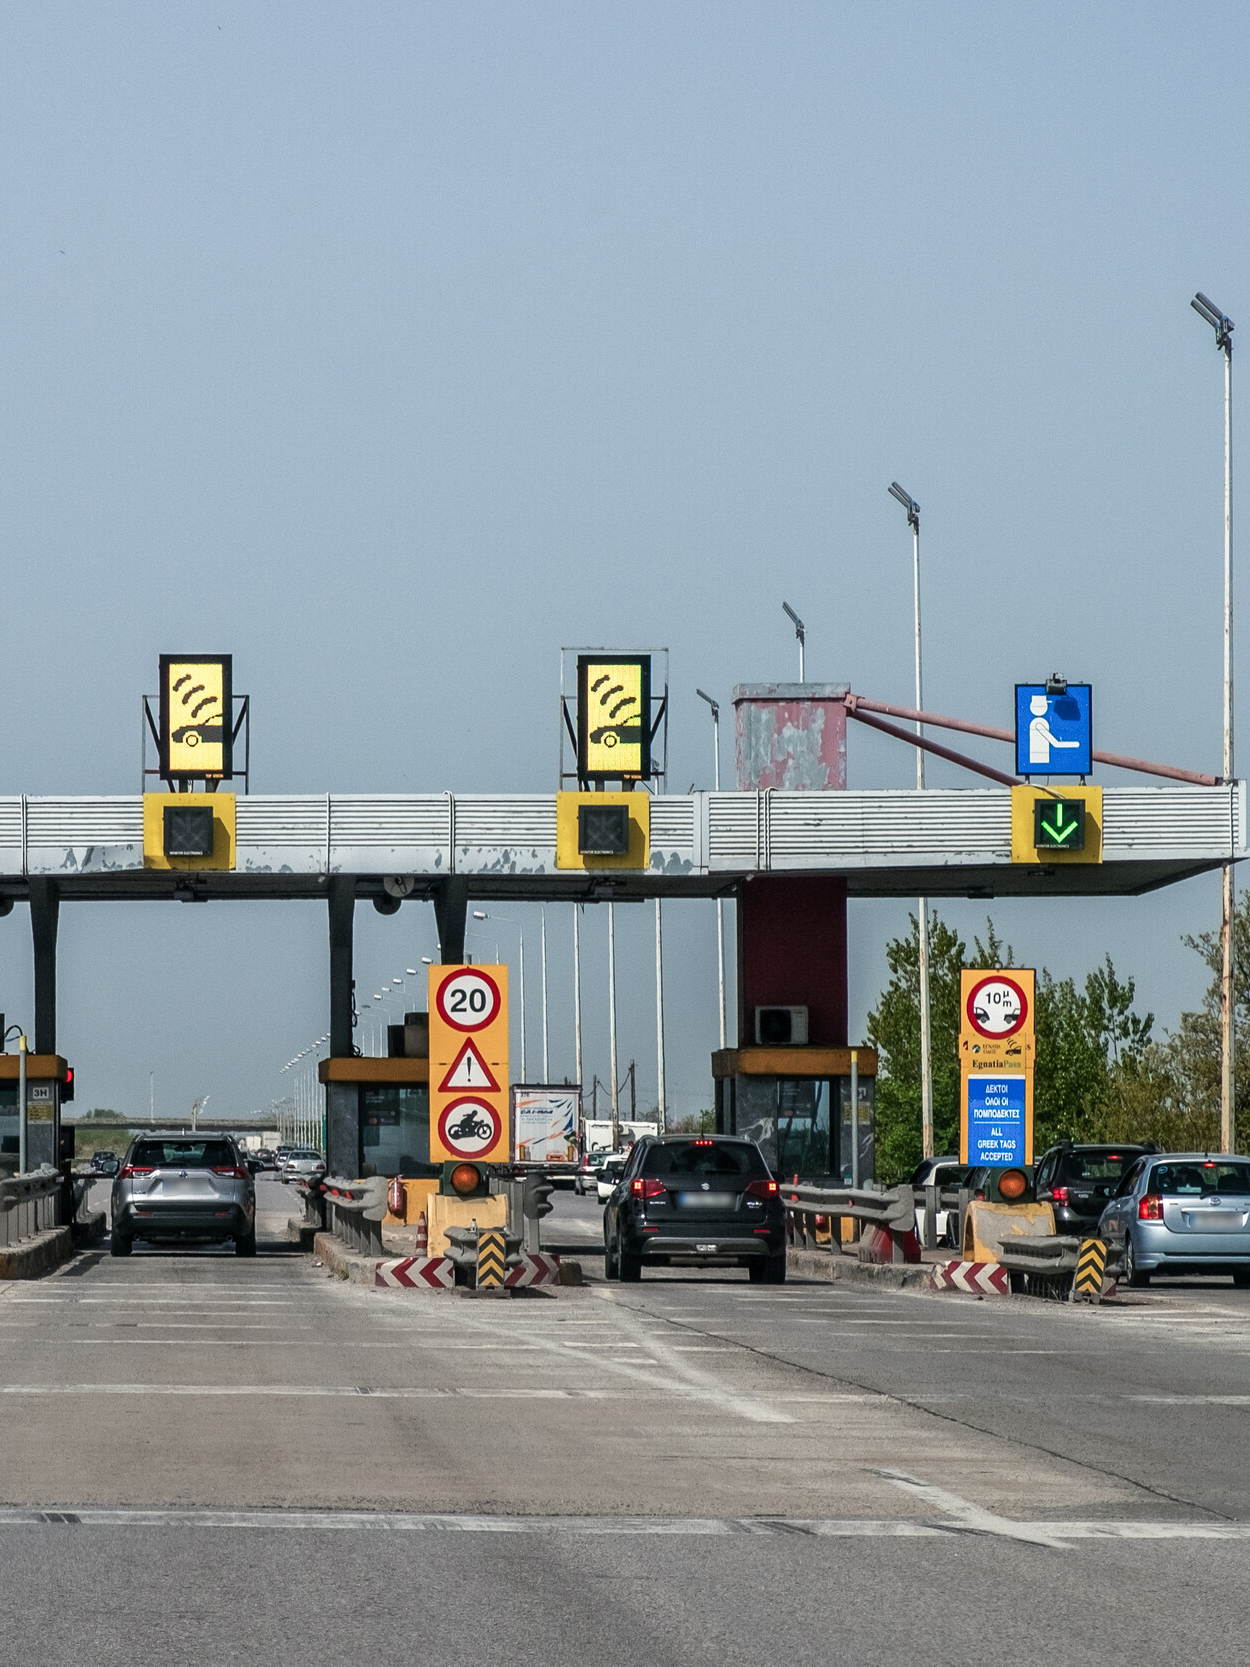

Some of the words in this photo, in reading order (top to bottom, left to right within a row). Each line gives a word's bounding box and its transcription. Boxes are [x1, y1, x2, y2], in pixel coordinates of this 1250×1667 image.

[450, 988, 486, 1012] 20
[986, 992, 1001, 1004] 10
[34, 1088, 47, 1097] 3H
[985, 1084, 1008, 1094] ΔΕΚΤΟΙ
[985, 1097, 1000, 1106] ΟΛΟΙ
[1002, 1097, 1008, 1106] ΟΙ
[973, 1109, 1020, 1119] ΠΟΜΠΟΔΕΚΤΕΣ
[991, 1127, 1002, 1136] ALL
[978, 1140, 998, 1148] GREEK
[1000, 1140, 1016, 1149] TAGS
[980, 1152, 1013, 1161] ACCEPTED
